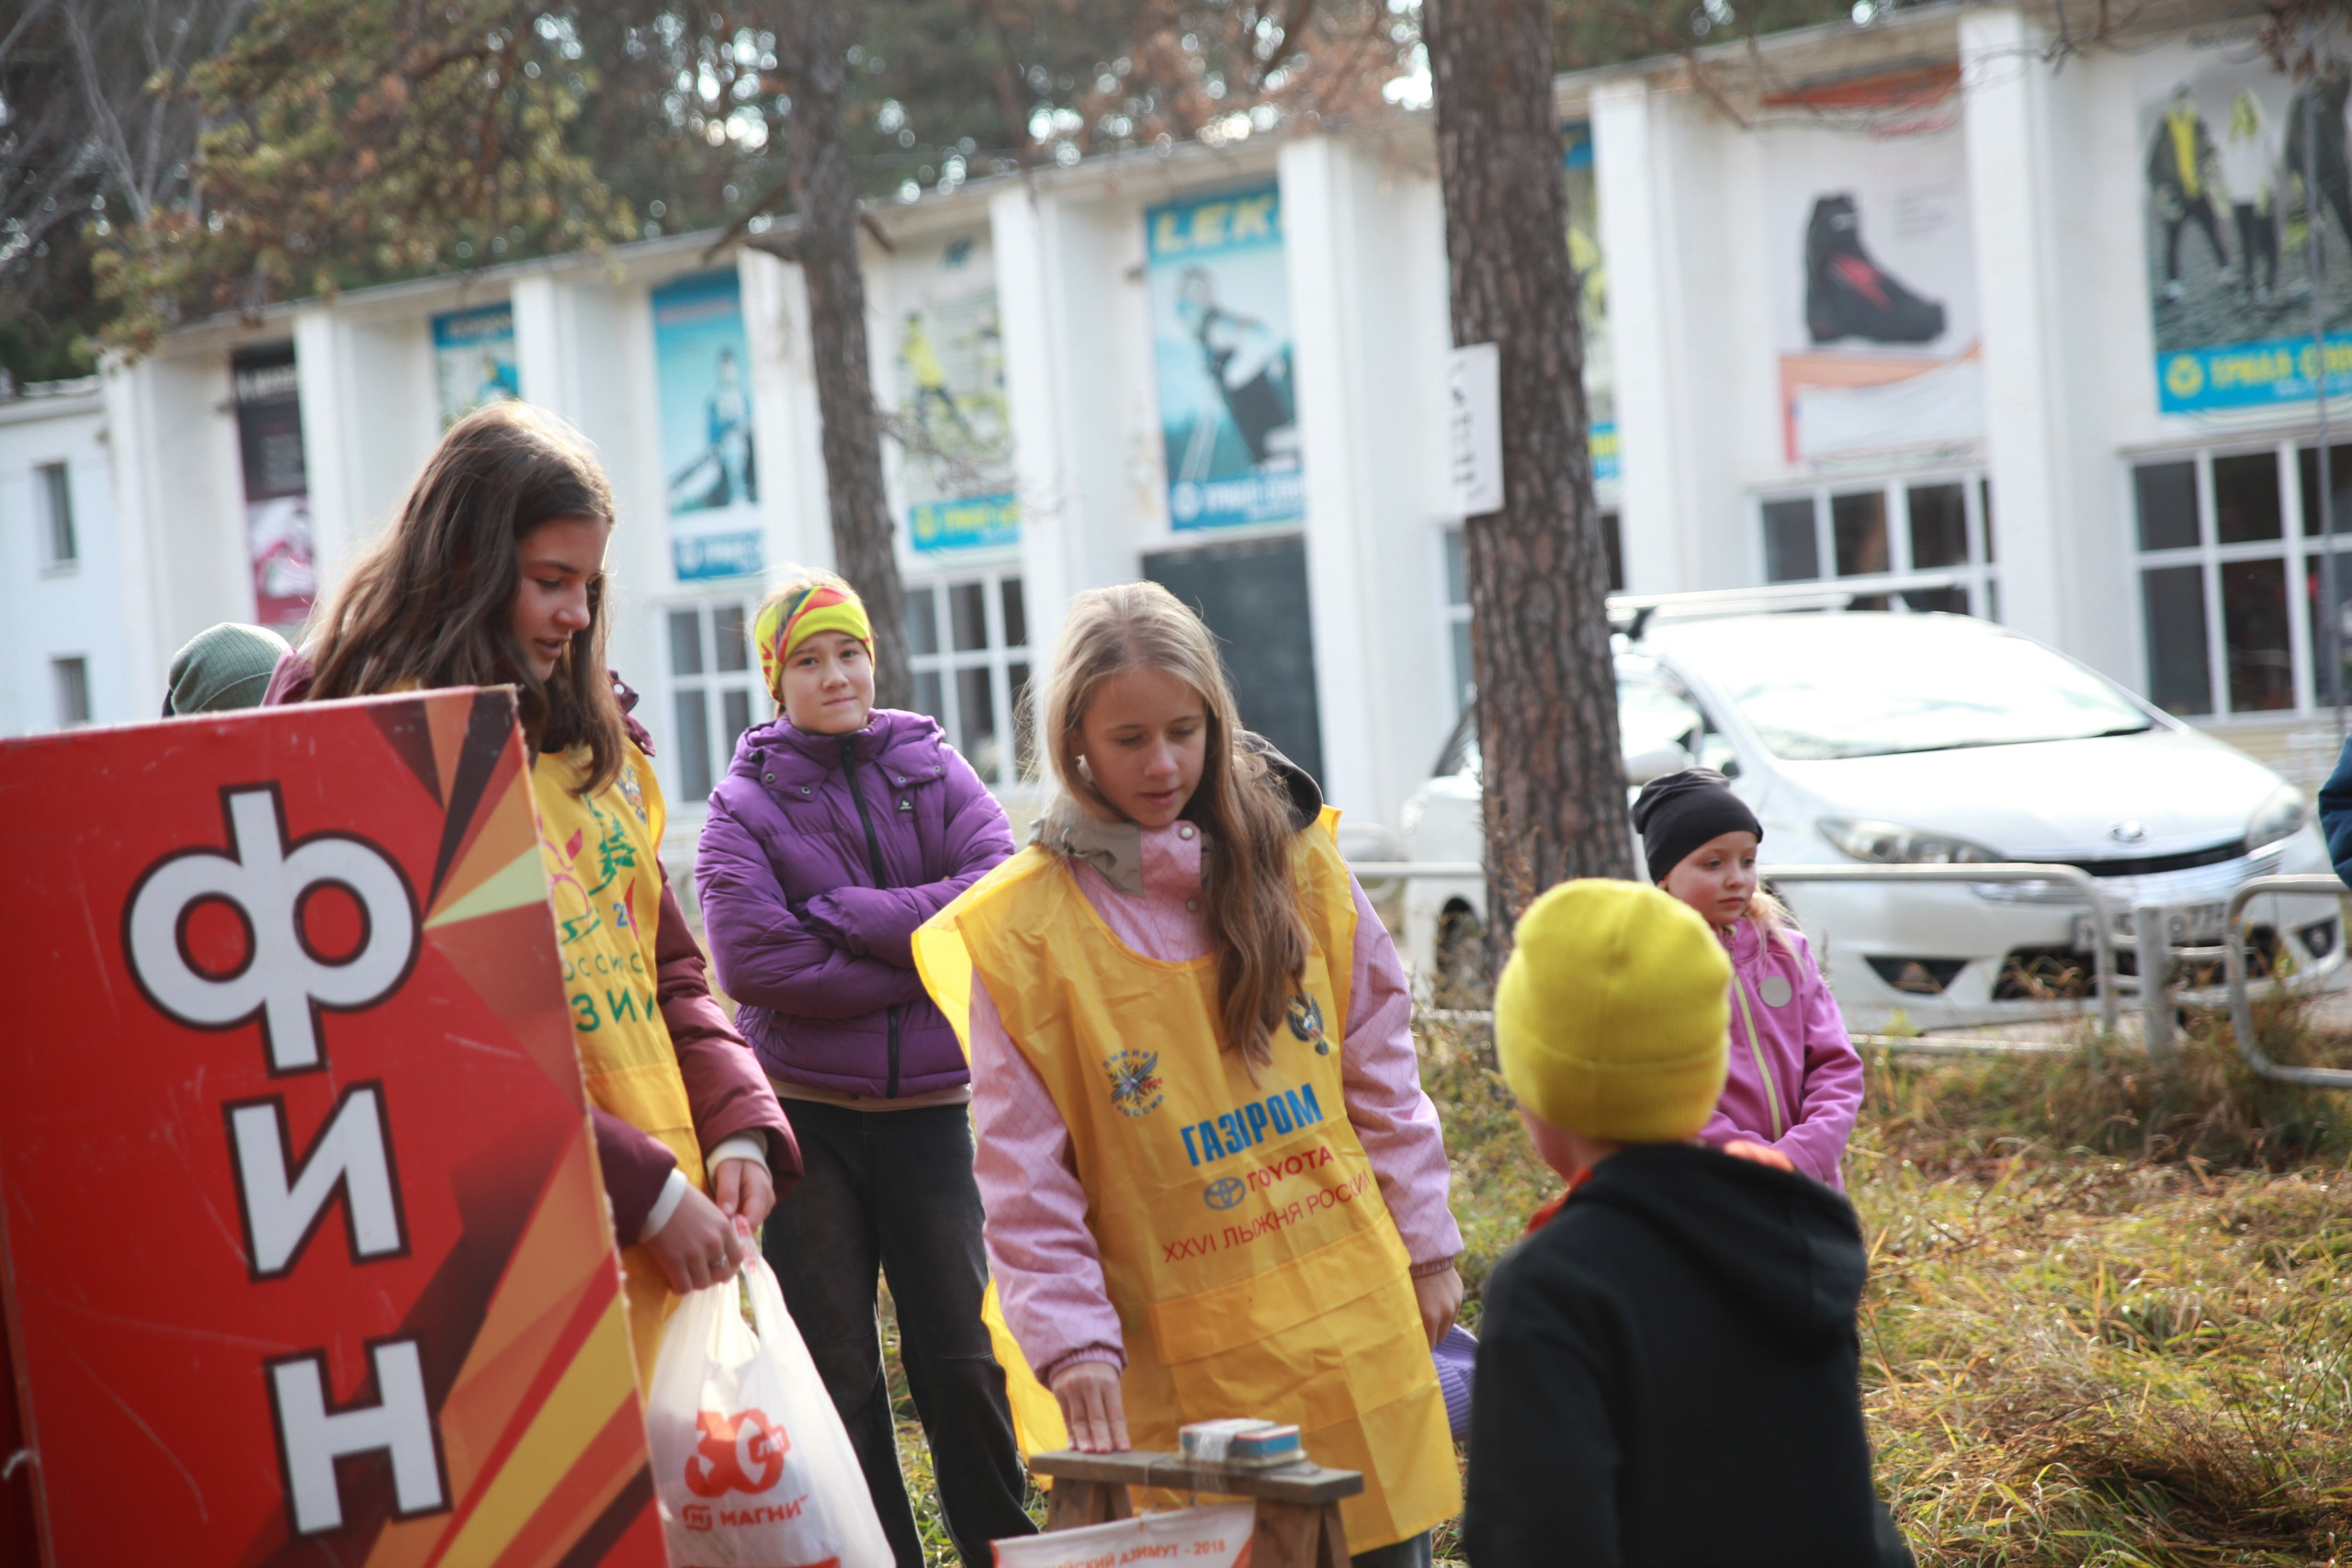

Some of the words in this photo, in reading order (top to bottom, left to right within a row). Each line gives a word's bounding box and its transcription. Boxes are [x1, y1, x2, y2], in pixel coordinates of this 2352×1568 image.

[1154, 191, 1283, 251] LEK
[1246, 1145, 1335, 1192] TOYOTA
[1162, 1233, 1217, 1264] XXVI
[1223, 1201, 1304, 1248] ЛЫЖНЯ
[1119, 1543, 1179, 1566] АЗИМУТ
[1193, 1539, 1226, 1555] 2018
